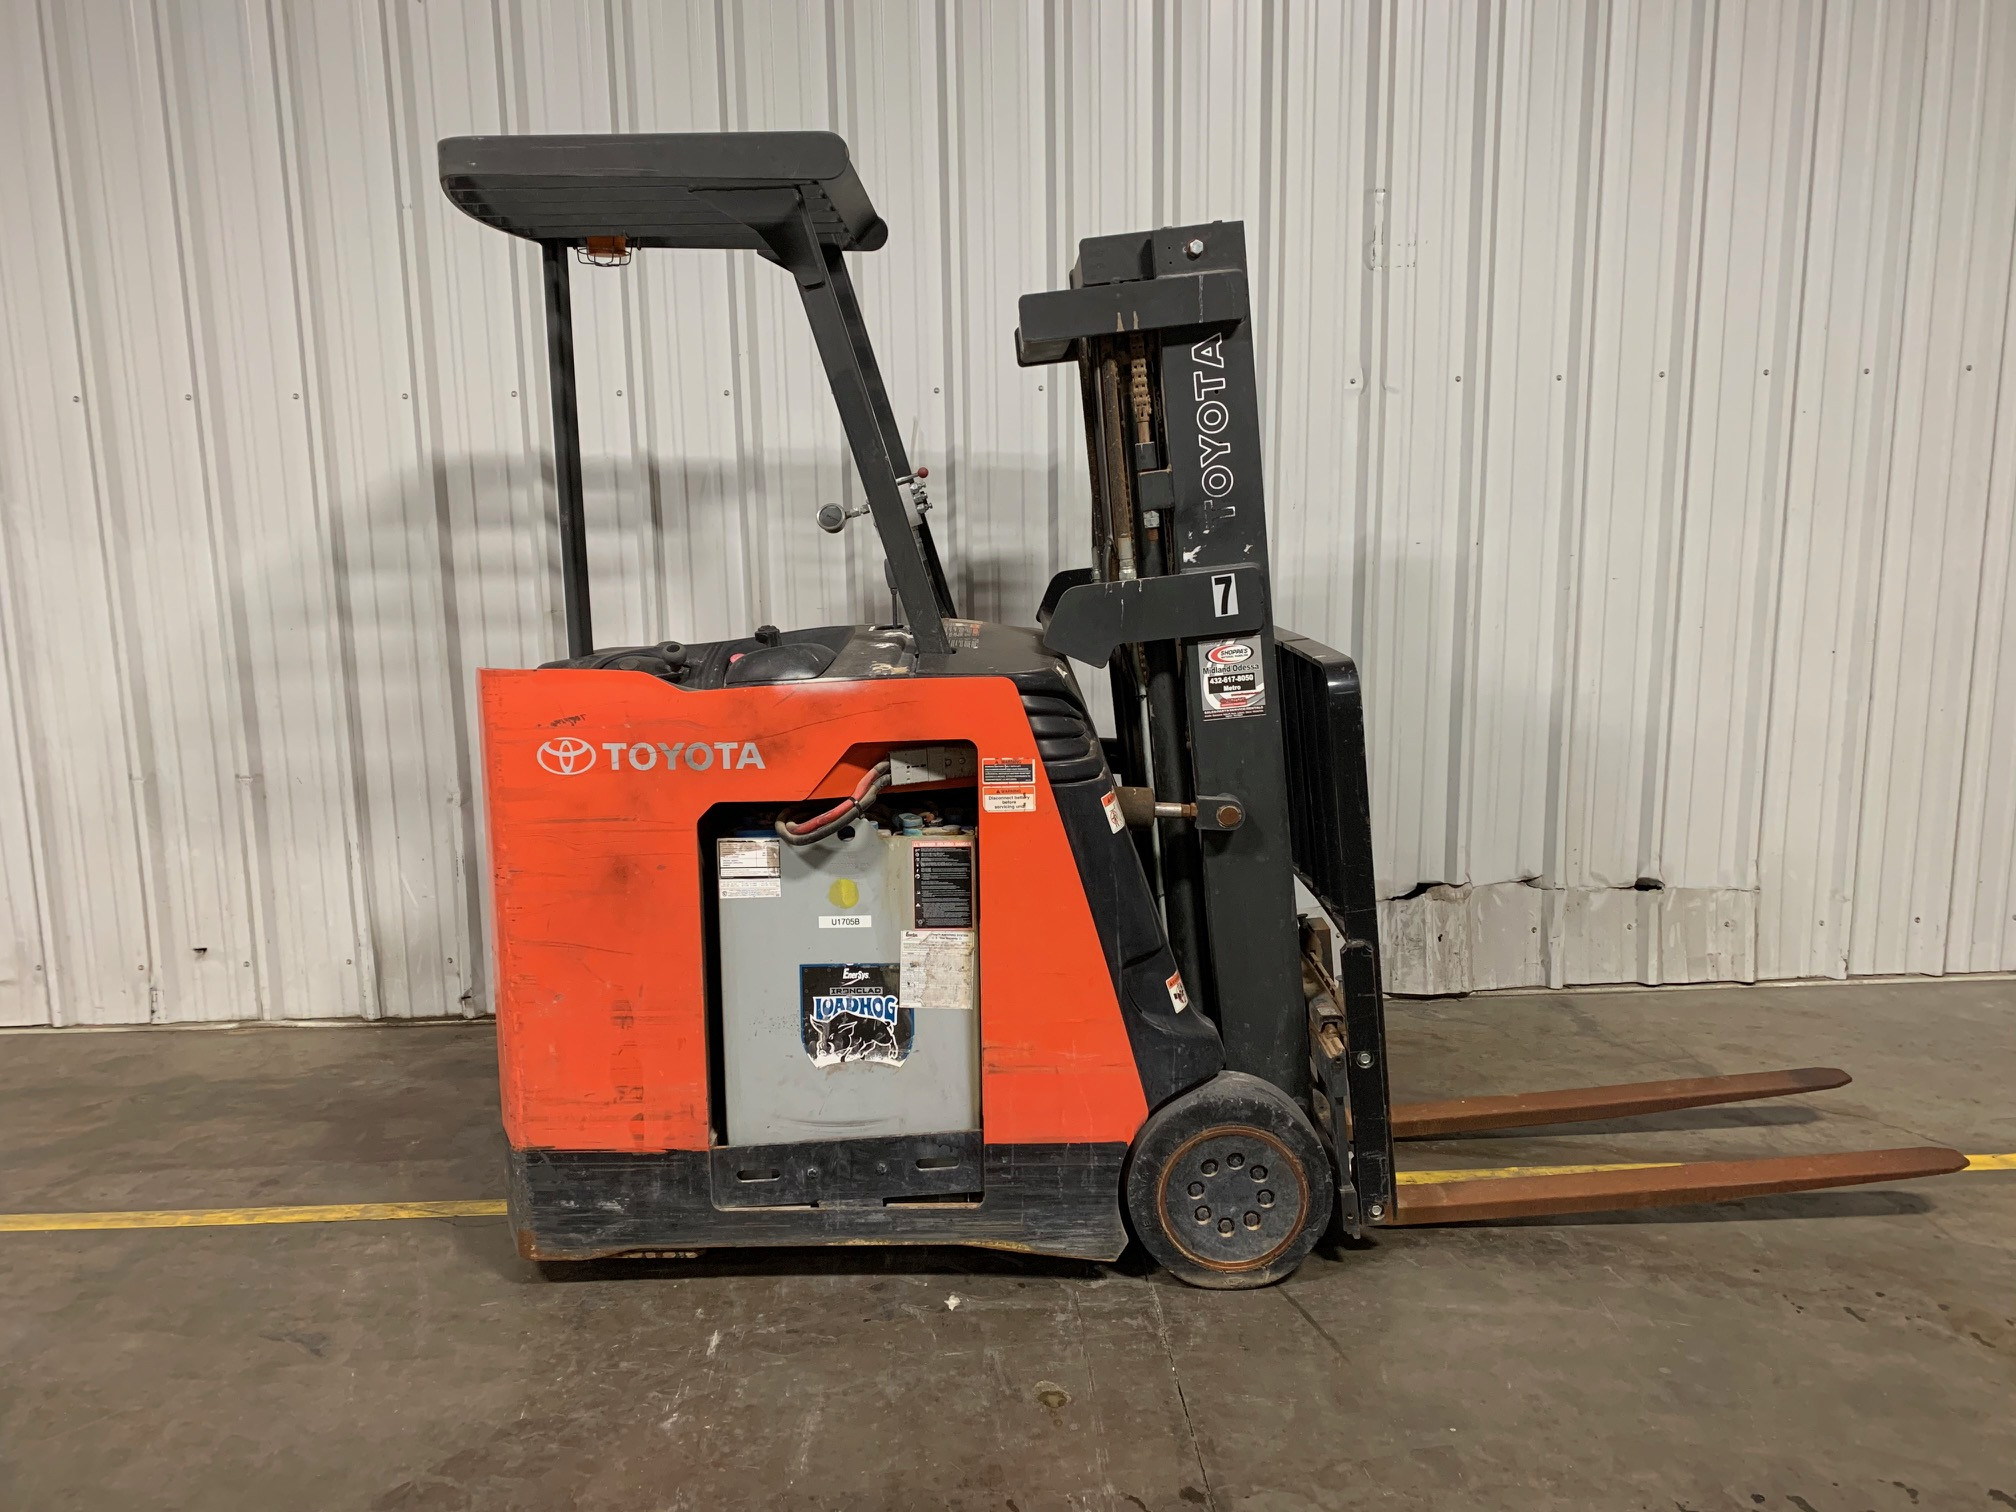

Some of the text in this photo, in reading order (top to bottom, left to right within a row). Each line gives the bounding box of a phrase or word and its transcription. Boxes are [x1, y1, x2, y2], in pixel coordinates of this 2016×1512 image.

[1214, 576, 1232, 615] 7
[1202, 664, 1260, 675] Midland Odessa
[1209, 674, 1254, 684] 432-617-8050
[602, 742, 766, 771] TOYOTA
[831, 918, 860, 926] U1705B
